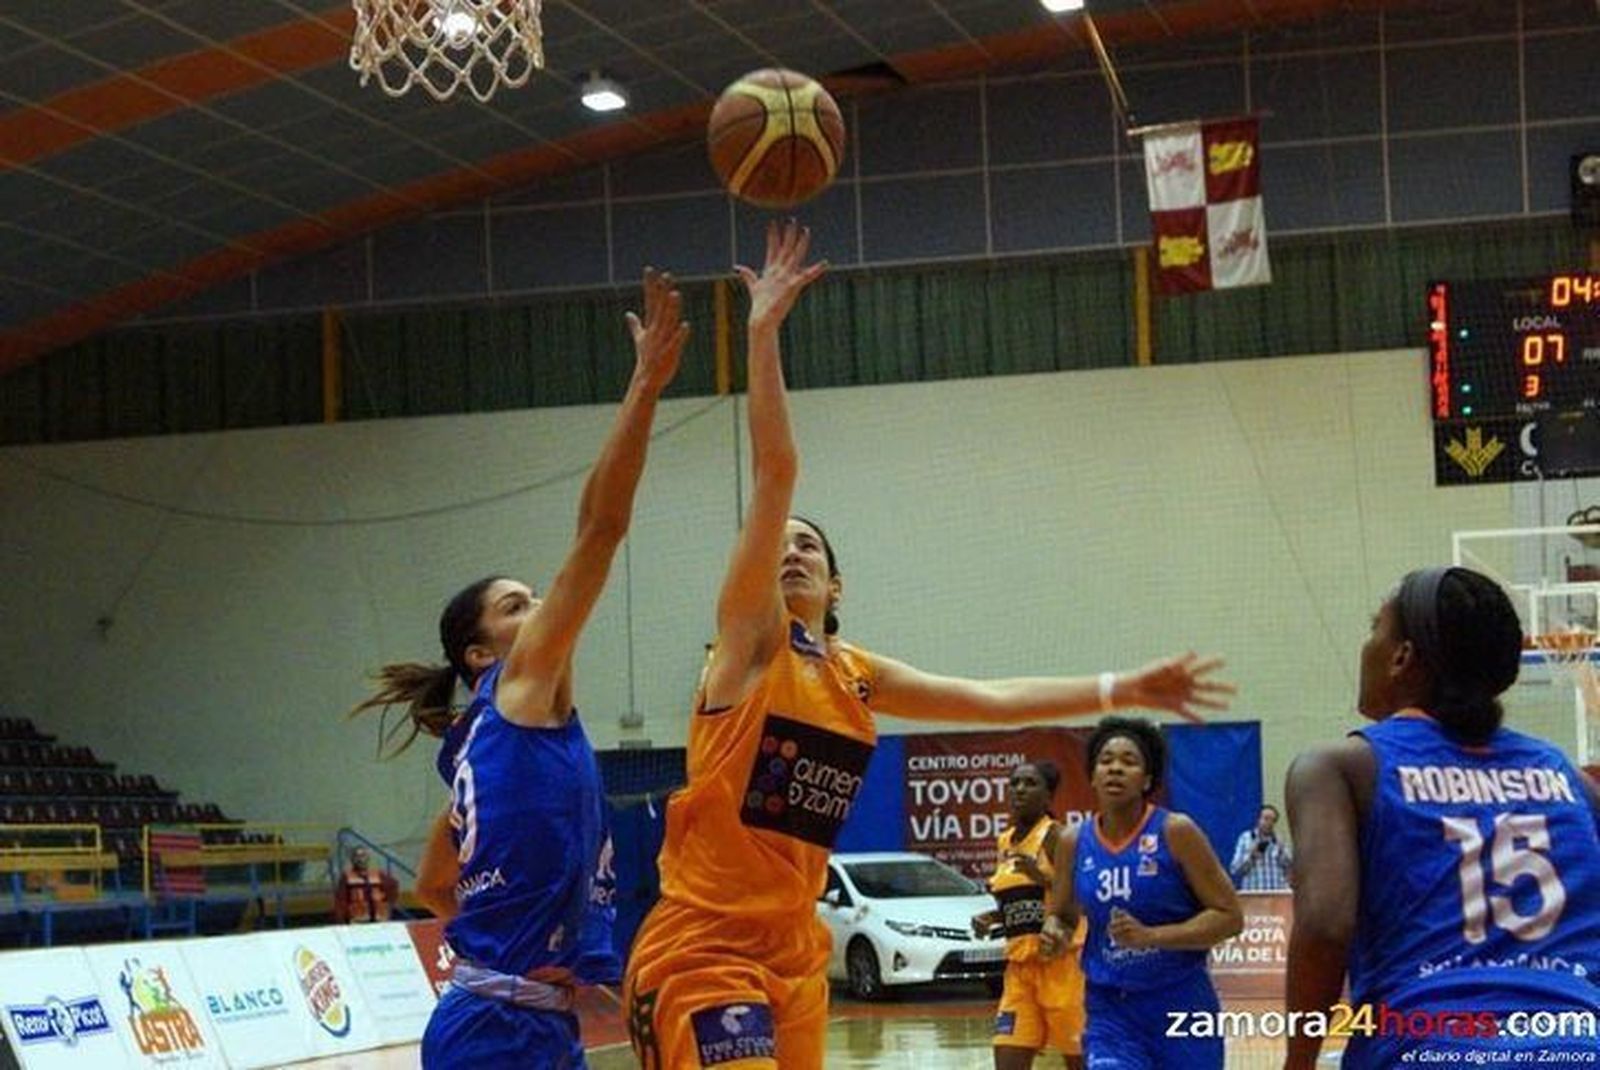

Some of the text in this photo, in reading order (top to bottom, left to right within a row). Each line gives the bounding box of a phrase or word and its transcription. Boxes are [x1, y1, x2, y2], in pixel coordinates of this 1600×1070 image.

[1513, 316, 1561, 331] LOCAL
[1524, 334, 1564, 365] 07
[1525, 375, 1539, 397] 3
[908, 756, 967, 770] CENTRO
[908, 777, 1010, 806] TOYOT
[1398, 766, 1576, 803] ROBINSON
[910, 808, 1010, 840] VÍA DE
[1096, 866, 1131, 902] 34
[1441, 812, 1567, 945] 15
[1224, 928, 1286, 944] YOTA
[1247, 946, 1273, 962] DE
[207, 987, 284, 1013] BLANCO
